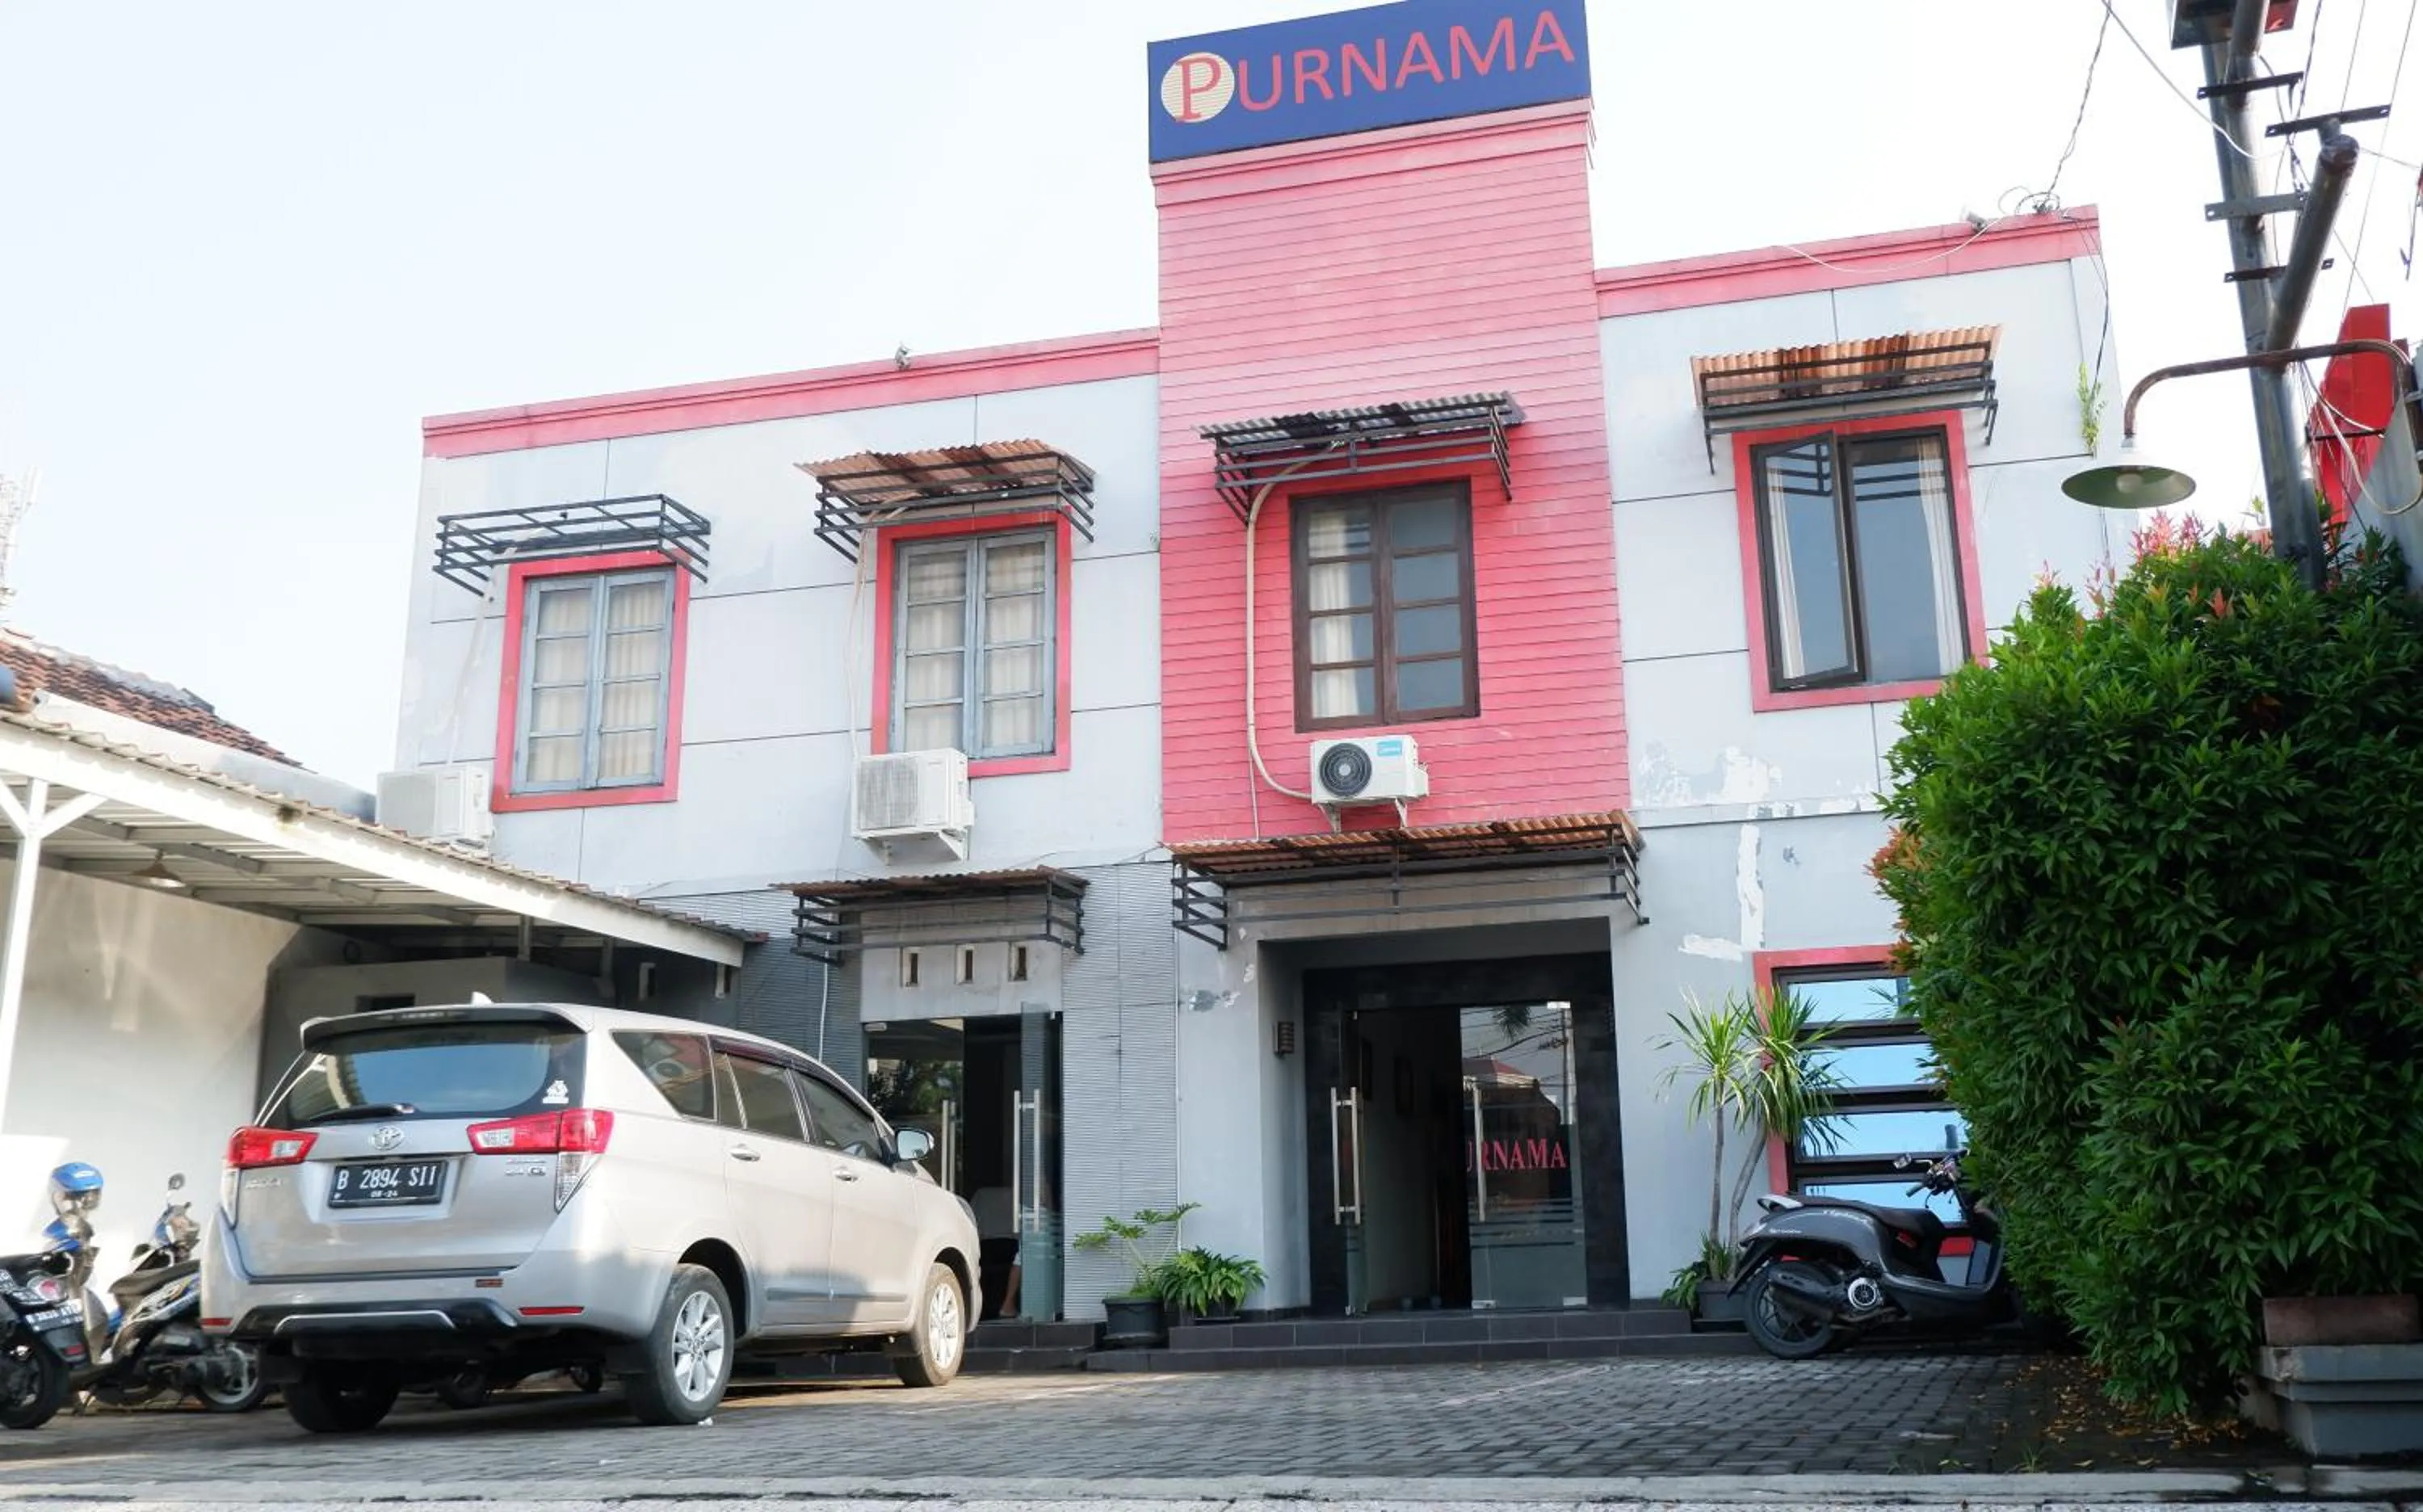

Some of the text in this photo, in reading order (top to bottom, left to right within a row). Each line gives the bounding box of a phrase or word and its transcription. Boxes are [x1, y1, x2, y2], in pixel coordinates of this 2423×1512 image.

[1175, 10, 1575, 123] PURNAMA
[337, 1170, 350, 1190] B
[359, 1168, 401, 1189] 2894
